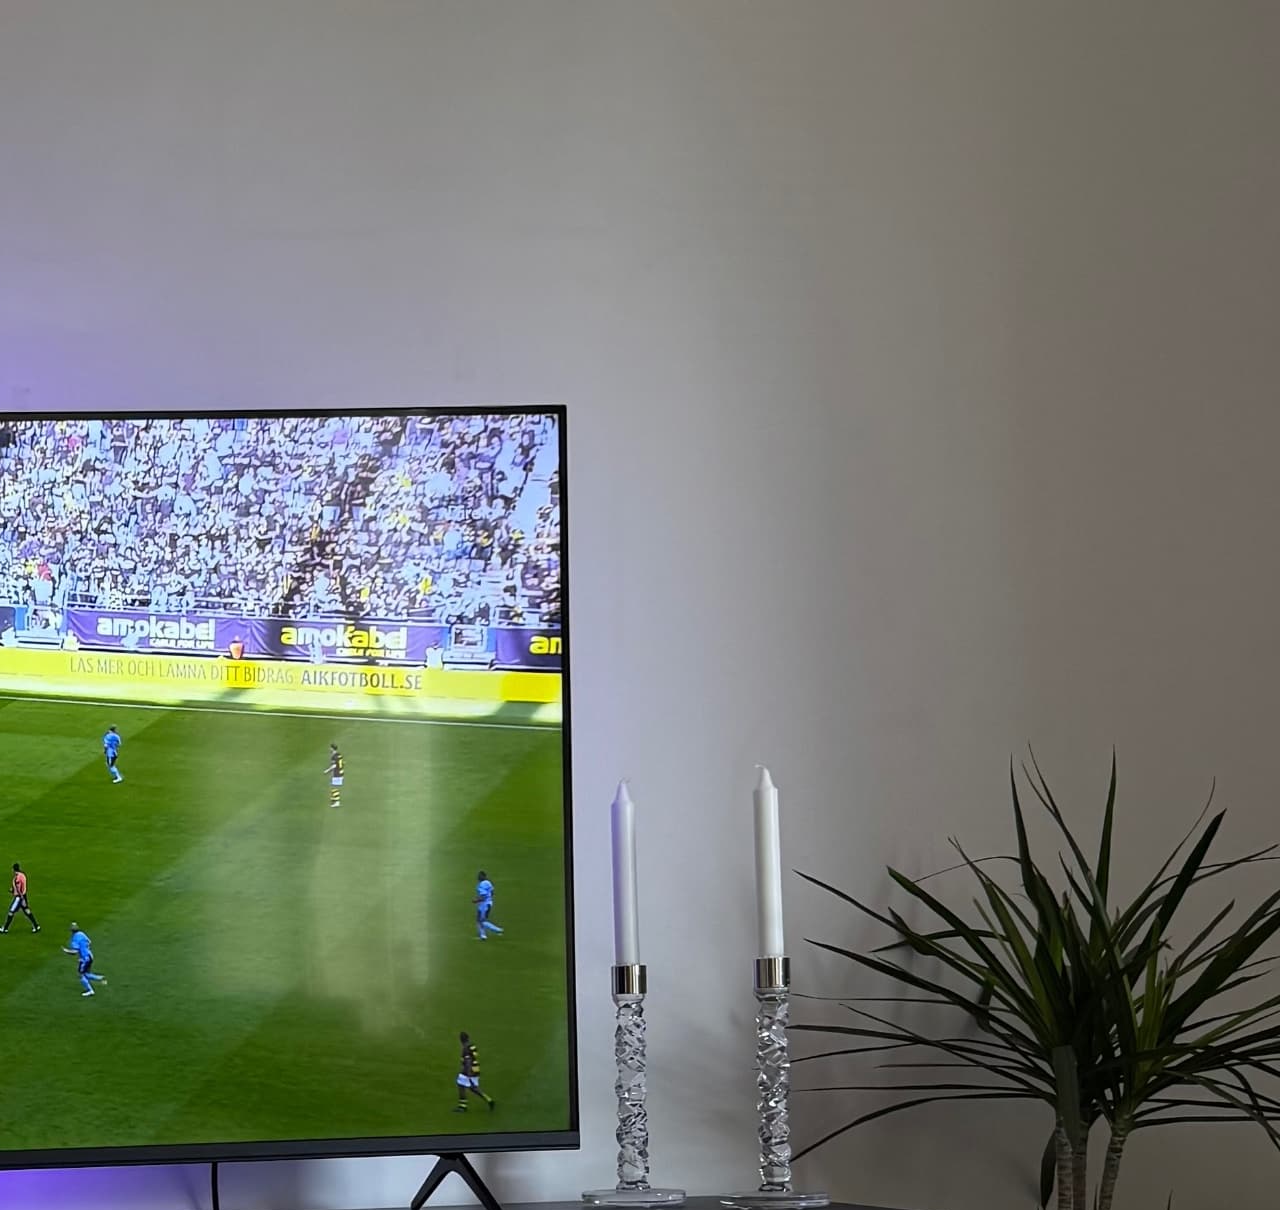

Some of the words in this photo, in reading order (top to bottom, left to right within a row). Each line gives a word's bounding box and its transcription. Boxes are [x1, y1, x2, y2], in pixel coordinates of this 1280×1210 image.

[96, 615, 216, 641] amokabel
[280, 624, 407, 649] amokabel
[97, 658, 124, 675] MER
[127, 660, 154, 677] OCH
[210, 664, 241, 682] DITT
[301, 670, 423, 690] AIKFOTBOLL.SE
